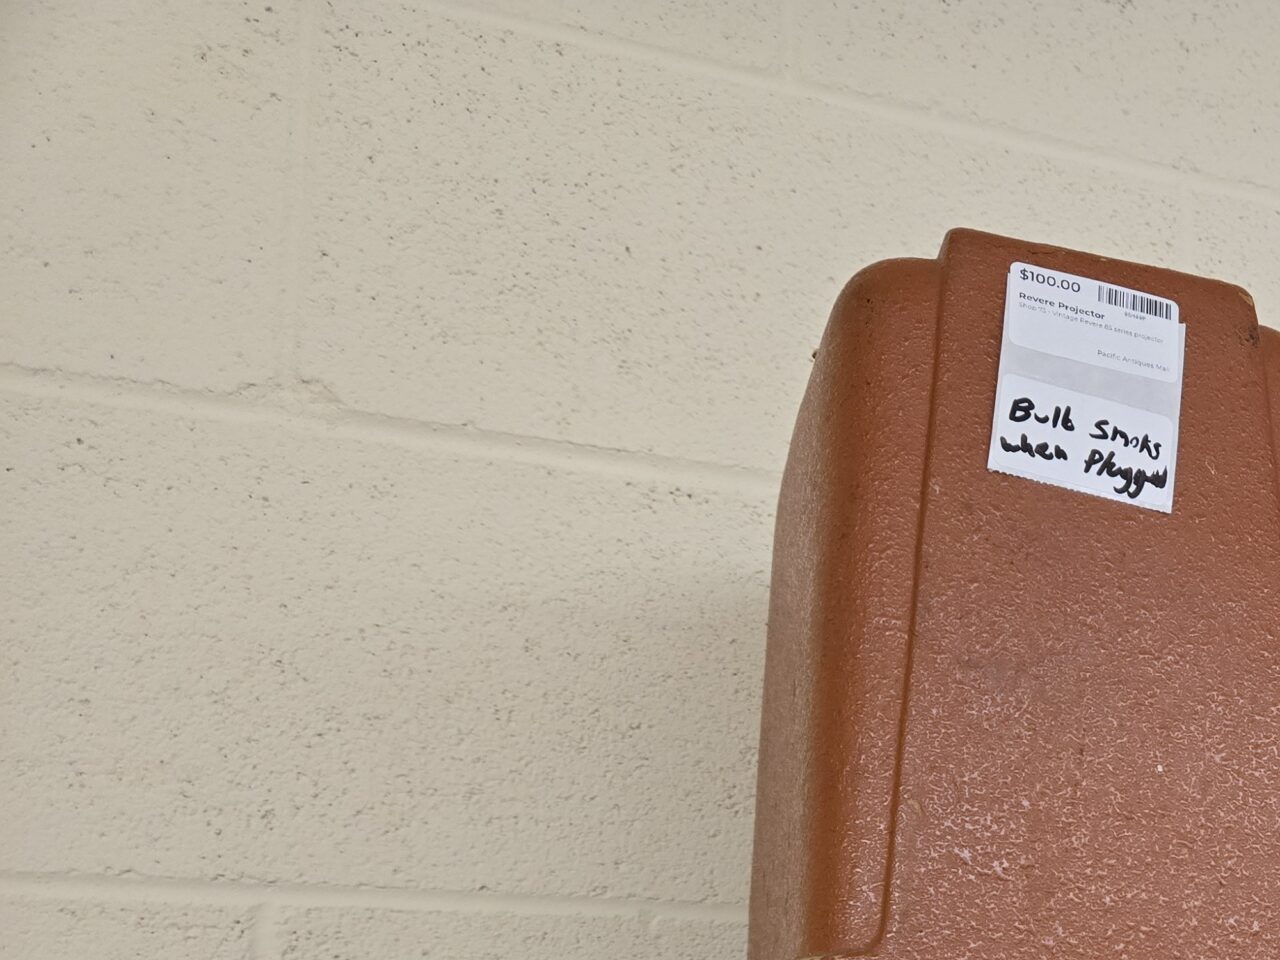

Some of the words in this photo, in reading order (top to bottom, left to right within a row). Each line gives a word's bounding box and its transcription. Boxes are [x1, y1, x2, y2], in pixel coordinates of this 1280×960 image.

[1020, 267, 1081, 293] $100.00
[1019, 292, 1055, 307] Revere
[1058, 301, 1105, 320] Projector
[1097, 348, 1120, 361] Pacific
[1122, 355, 1154, 369] Antiques
[1009, 397, 1075, 432] Bulb
[1000, 433, 1068, 461] when
